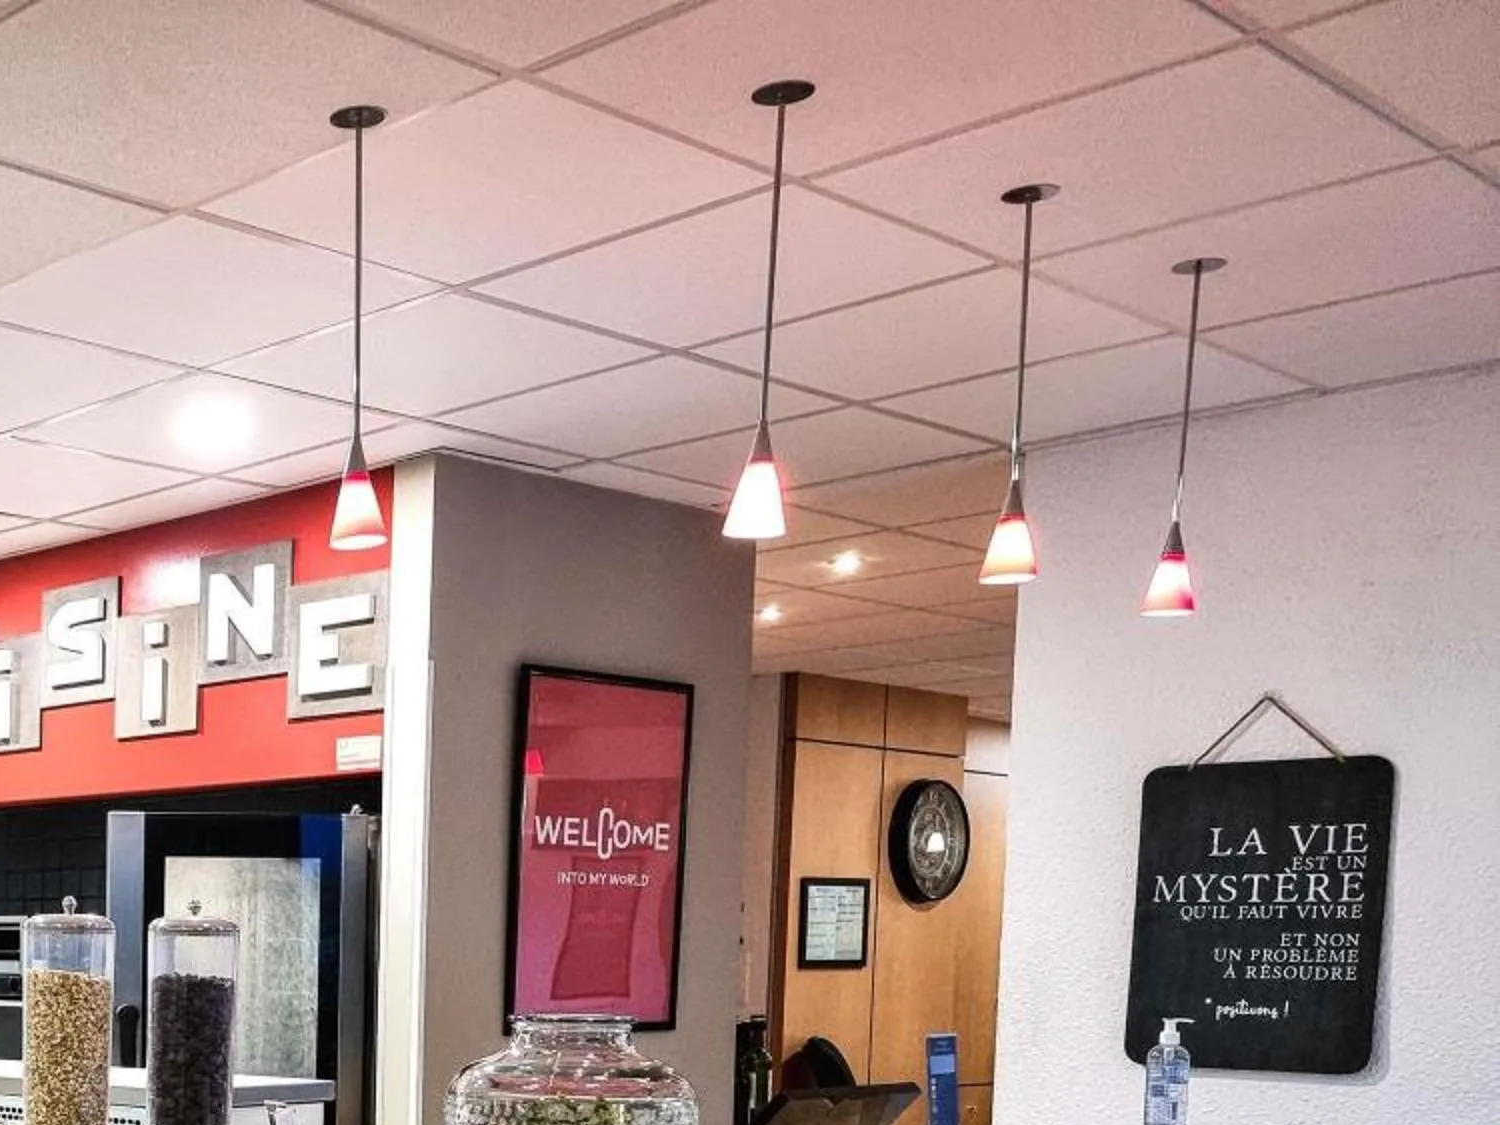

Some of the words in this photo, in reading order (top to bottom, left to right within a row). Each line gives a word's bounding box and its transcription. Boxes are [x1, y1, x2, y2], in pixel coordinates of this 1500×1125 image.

[535, 808, 670, 859] WELCOME
[1207, 827, 1268, 857] LA
[1288, 823, 1369, 855] VIE
[1292, 856, 1328, 871] EST
[1337, 855, 1368, 869] UN
[557, 871, 587, 885] INTO
[589, 872, 607, 885] MY
[1153, 867, 1366, 903] MYSTÈRE
[1180, 904, 1231, 922] QU'IL
[1238, 905, 1288, 919] FAUT
[1296, 903, 1363, 919] VIVRE
[1280, 932, 1307, 947] ET
[1313, 932, 1361, 947] NON
[1213, 947, 1243, 963] UN
[1250, 945, 1360, 963] PROBLÈME
[1245, 963, 1358, 981] RÉSOUDRE
